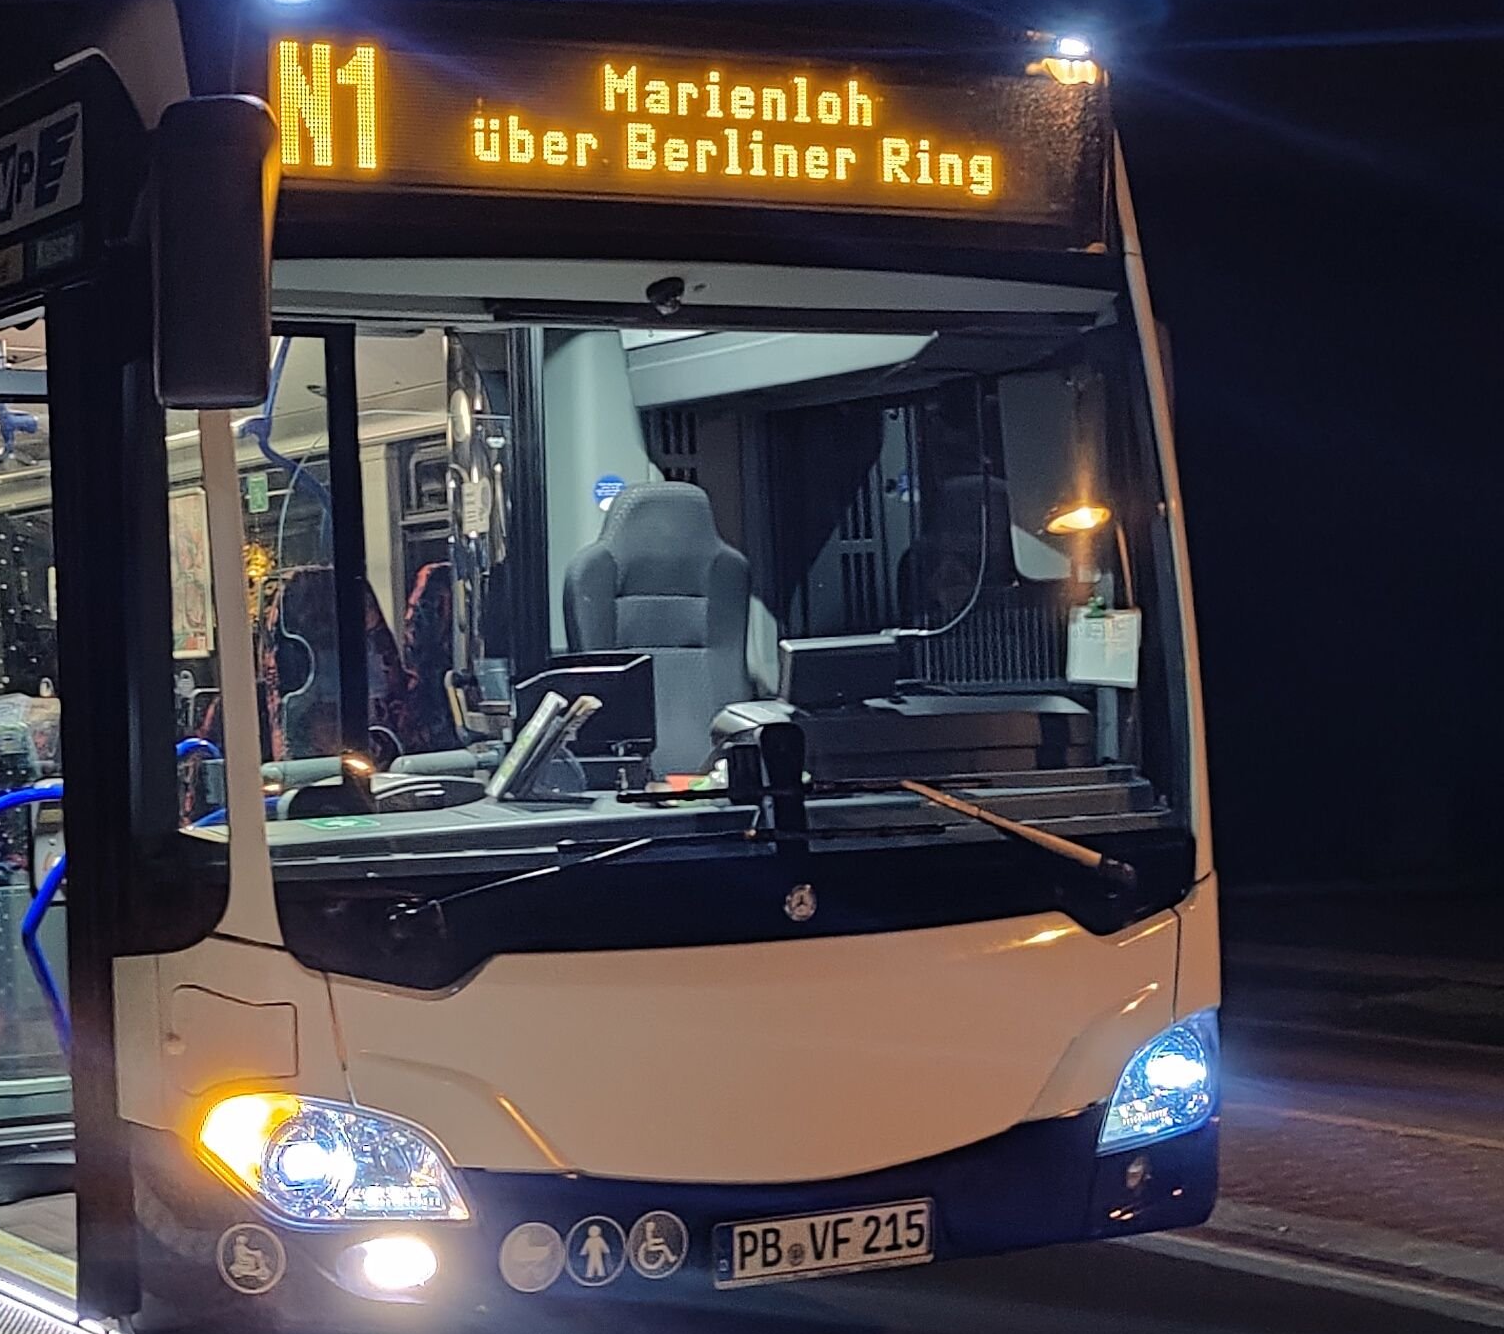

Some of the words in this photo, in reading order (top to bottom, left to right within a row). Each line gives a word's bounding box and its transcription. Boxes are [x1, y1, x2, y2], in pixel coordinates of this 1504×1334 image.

[278, 40, 377, 169] N1
[603, 63, 873, 127] Marienloh
[472, 115, 598, 167] über
[626, 122, 857, 181] Berliner
[882, 136, 994, 196] Ring
[737, 1227, 783, 1271] PB
[808, 1217, 854, 1261] VF
[862, 1209, 926, 1255] 215
